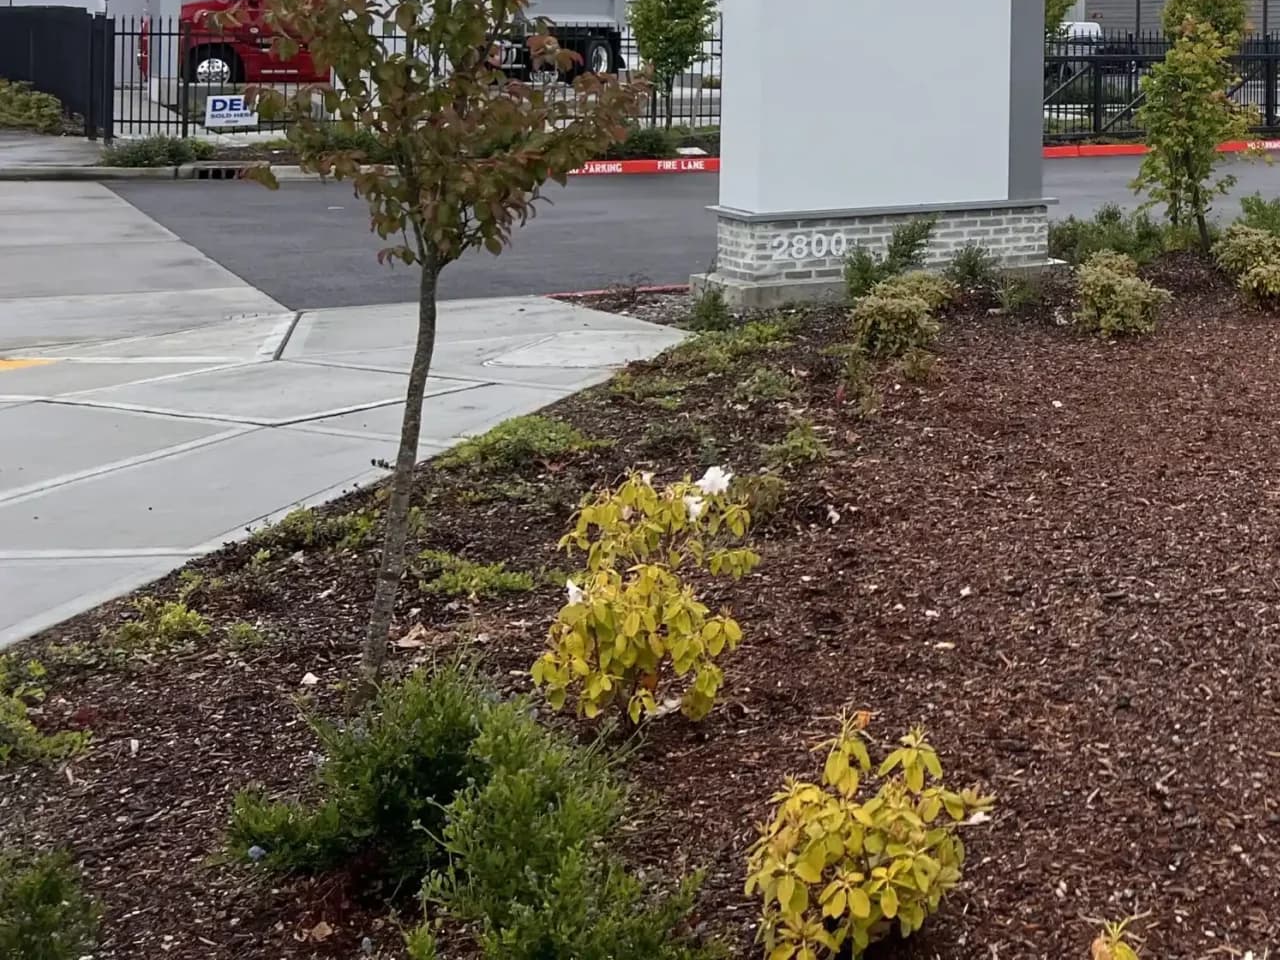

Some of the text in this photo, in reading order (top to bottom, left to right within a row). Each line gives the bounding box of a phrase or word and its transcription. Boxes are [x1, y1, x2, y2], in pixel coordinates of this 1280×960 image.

[657, 160, 677, 170] FIRE
[681, 160, 705, 170] LANE
[772, 231, 847, 261] 2800
